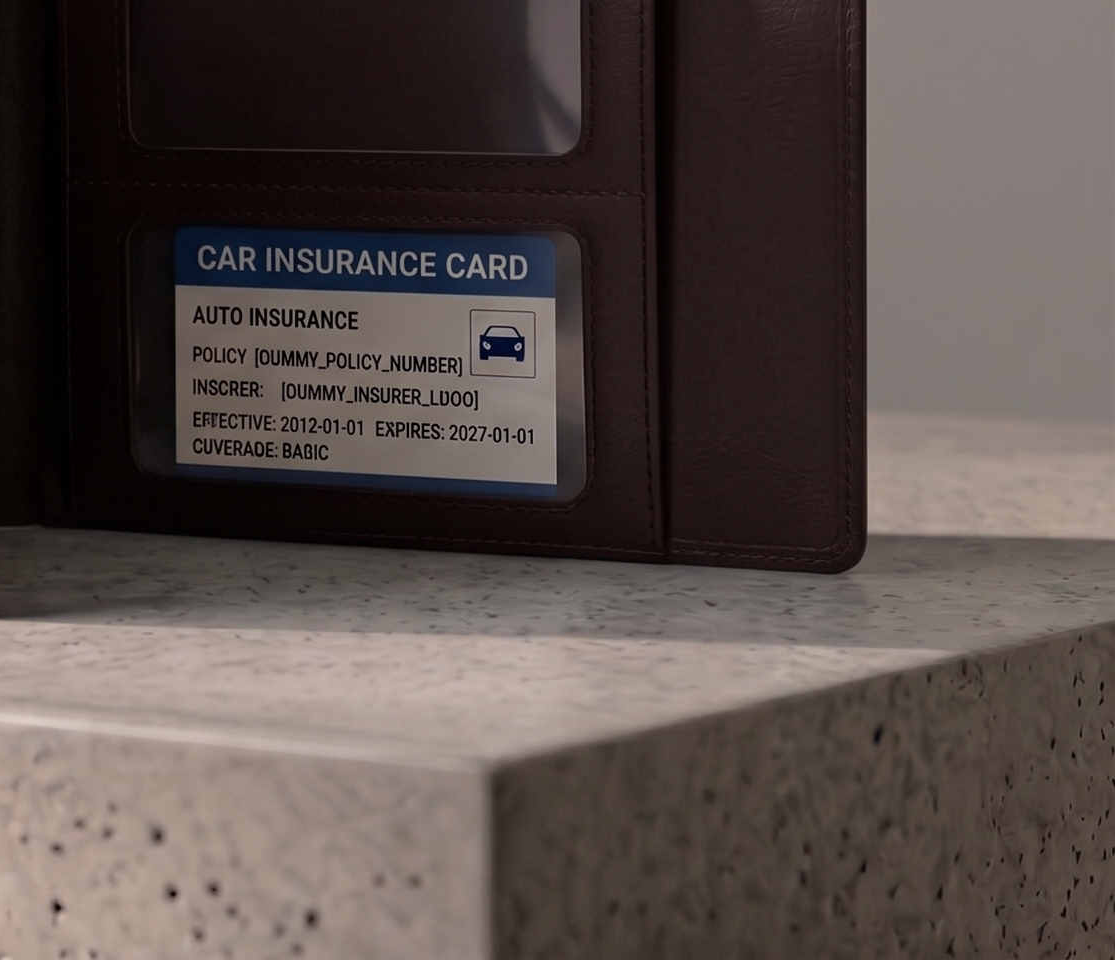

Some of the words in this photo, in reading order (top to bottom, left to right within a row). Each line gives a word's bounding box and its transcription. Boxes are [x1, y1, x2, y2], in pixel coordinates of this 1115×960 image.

[197, 244, 257, 272] CAR
[265, 246, 437, 278] INSURANCE
[446, 252, 529, 281] CARD
[192, 305, 243, 326] AUTO
[249, 307, 359, 330] INSURANCE
[192, 346, 248, 365] POLICY
[280, 415, 364, 436] 2012-01-01
[375, 420, 445, 440] EXPIRES:
[449, 424, 534, 445] 2027-01-01
